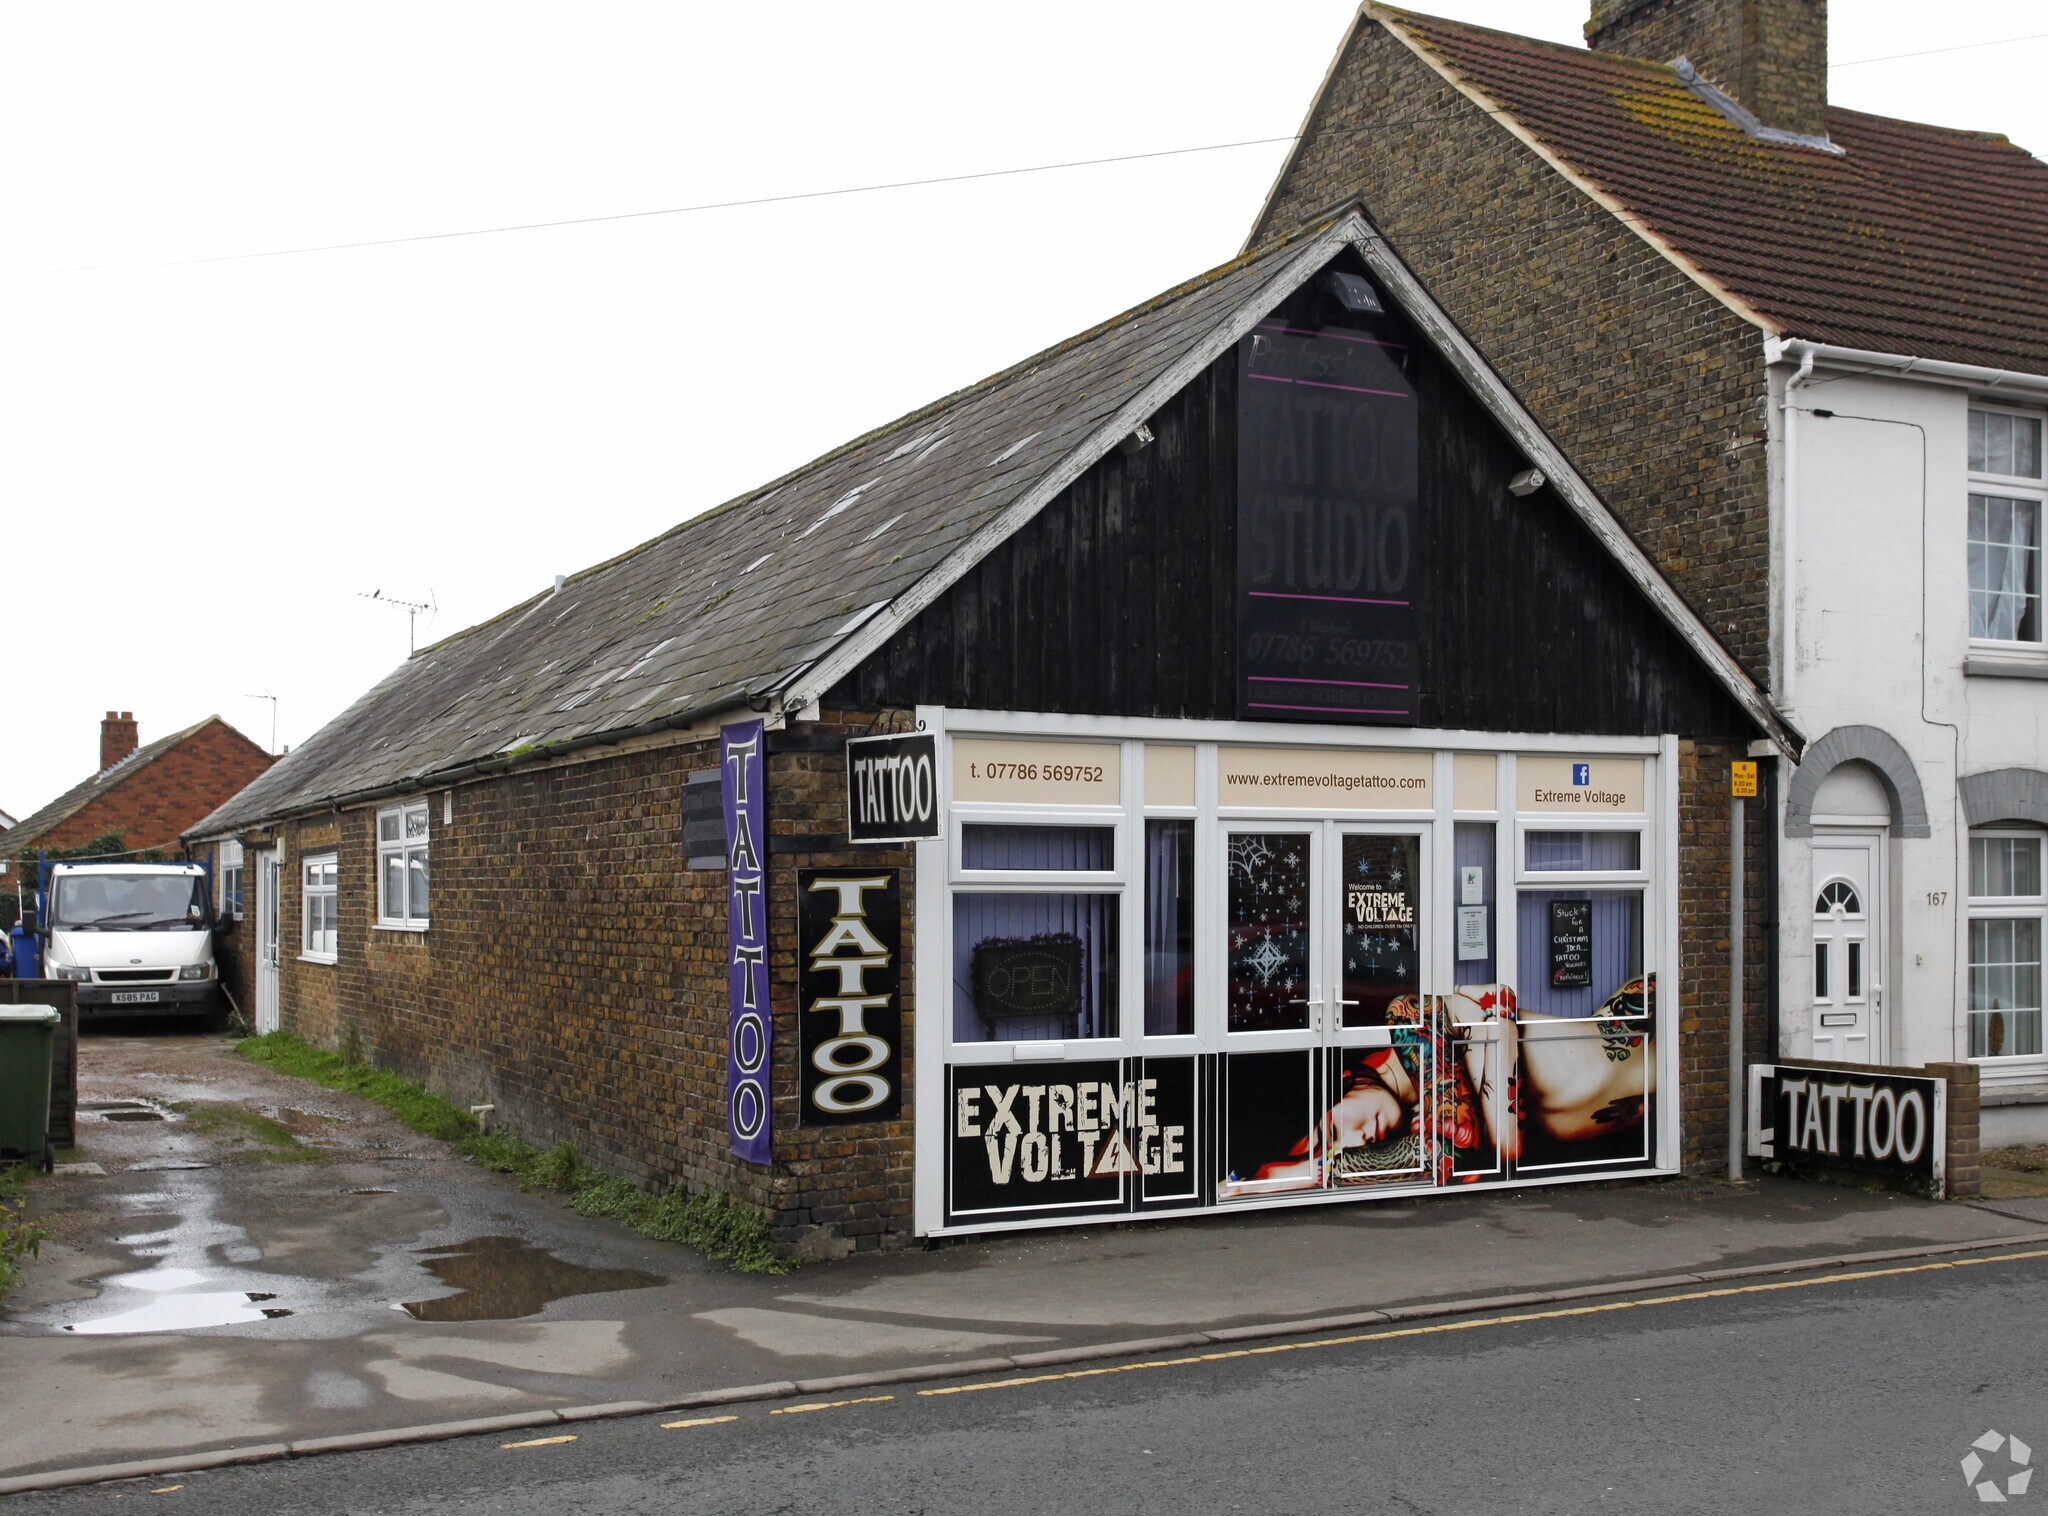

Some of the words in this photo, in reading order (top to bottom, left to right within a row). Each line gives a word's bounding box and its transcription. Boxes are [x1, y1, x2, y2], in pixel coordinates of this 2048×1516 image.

[1250, 390, 1409, 494] TATTOO
[1251, 491, 1410, 594] STUDIO
[1247, 632, 1318, 664] 07786
[1325, 637, 1409, 668] 569752
[854, 754, 933, 824] TATTOO
[970, 762, 981, 778] t.
[986, 762, 1037, 780] 07786
[1042, 765, 1103, 782] 569752
[1227, 772, 1426, 790] www.extremevoltagetattoo.com
[1534, 788, 1581, 803] Extreme
[1584, 790, 1626, 807] Voltage
[1348, 892, 1405, 908] EXTREME
[1356, 906, 1413, 922] VOLTAGE
[1557, 907, 1579, 917] Stuck
[1926, 892, 1947, 906] 167
[727, 738, 766, 1140] TATTOO
[1555, 954, 1580, 962] TATTOO
[115, 993, 138, 1002] X585
[139, 992, 157, 1001] PAG
[808, 875, 893, 1114] TATTOO
[987, 963, 1072, 999] OPEN
[958, 1079, 1157, 1137] EXTREME
[1781, 1075, 1926, 1164] TATTOO
[984, 1125, 1185, 1185] VOLTAGE
